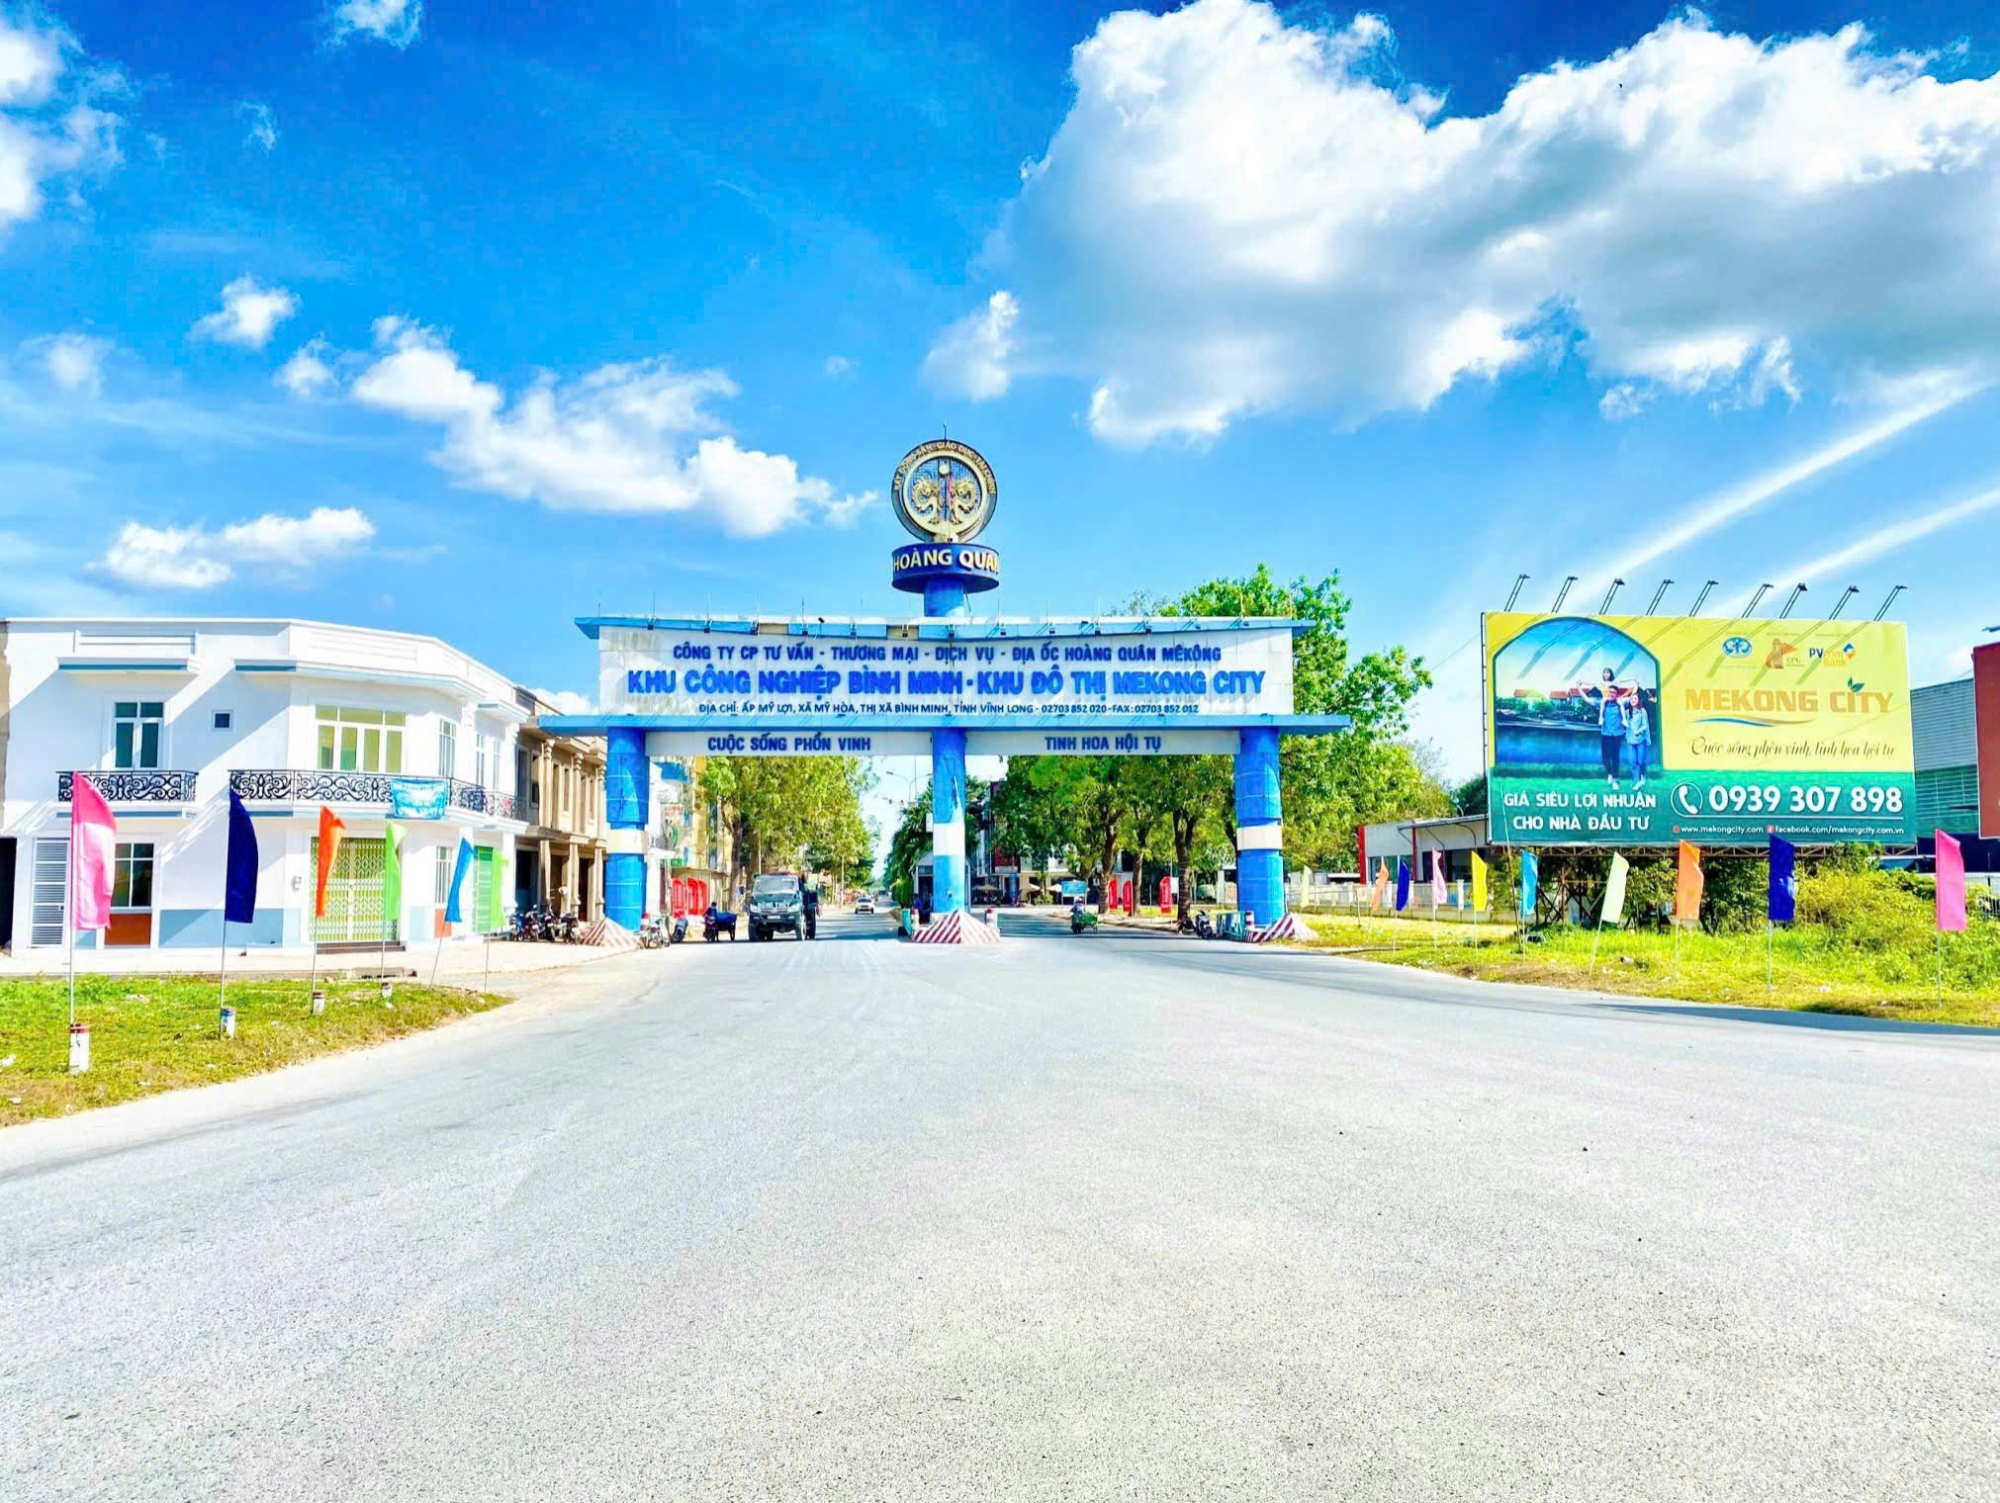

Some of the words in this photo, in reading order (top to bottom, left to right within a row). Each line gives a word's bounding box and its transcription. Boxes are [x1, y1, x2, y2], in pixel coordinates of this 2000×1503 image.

[893, 547, 952, 571] HOÀNG
[673, 641, 711, 660] CÔNG
[717, 646, 735, 660] TY
[740, 646, 758, 660] CP
[763, 645, 782, 660] TƯ
[786, 641, 814, 660] VẤN
[831, 645, 886, 661] THƯƠNG
[892, 646, 918, 664] MẠI
[935, 646, 967, 665] DỊCH
[975, 647, 995, 665] VỤ
[1012, 647, 1035, 665] ĐỊA
[1040, 641, 1059, 661] ỐC
[1065, 643, 1112, 661] HOÀNG
[1118, 644, 1156, 661] QUÂN
[1162, 644, 1222, 661] MÊKÔNG
[628, 670, 677, 693] KHU
[684, 663, 751, 693] CÔNG
[758, 664, 841, 701] NGHIỆP
[848, 664, 901, 694] BÌNH
[907, 671, 963, 694] MINH
[977, 671, 1024, 695] KHU
[1031, 664, 1064, 694] ĐÔ
[1071, 671, 1107, 701] THỊ
[1112, 670, 1207, 694] MEKONG
[1213, 670, 1266, 694] CITY
[699, 703, 716, 715] ĐỊA
[741, 701, 755, 713] ẤP
[758, 702, 774, 713] MỸ
[798, 702, 812, 713] XÃ
[814, 702, 830, 713] MỸ
[860, 704, 876, 715] THỊ
[879, 702, 893, 713] XÃ
[895, 702, 919, 713] BÌNH
[1007, 704, 1033, 713] LONG
[1041, 704, 1070, 713] 02703
[1071, 704, 1088, 713] 852
[1135, 704, 1162, 713] 02703
[1164, 704, 1180, 713] 852
[1182, 704, 1199, 713] 012
[1685, 688, 1819, 713] MEKONG
[1830, 691, 1893, 713] CITY
[707, 733, 745, 754] CUỘC
[750, 732, 787, 751] SỐNG
[838, 737, 871, 751] VINH
[1045, 736, 1077, 750] TINH
[1082, 737, 1109, 750] HOA
[1115, 733, 1139, 753] HỘI
[1144, 737, 1162, 753] TỤ
[1504, 790, 1529, 808] GIÁ
[1535, 791, 1568, 808] SIÊU
[1575, 793, 1597, 810] LỢI
[1603, 790, 1656, 811] NHUẬN
[1709, 785, 1781, 812] 0939
[1789, 786, 1841, 813] 307
[1851, 786, 1903, 814] 898
[1513, 815, 1544, 830] CHO
[1549, 813, 1581, 831] NHÀ
[1628, 815, 1650, 831] TƯ
[1681, 825, 1764, 834] www.mekongcity.com
[1775, 825, 1904, 834] facebook.com/mekongcity.com.vn
